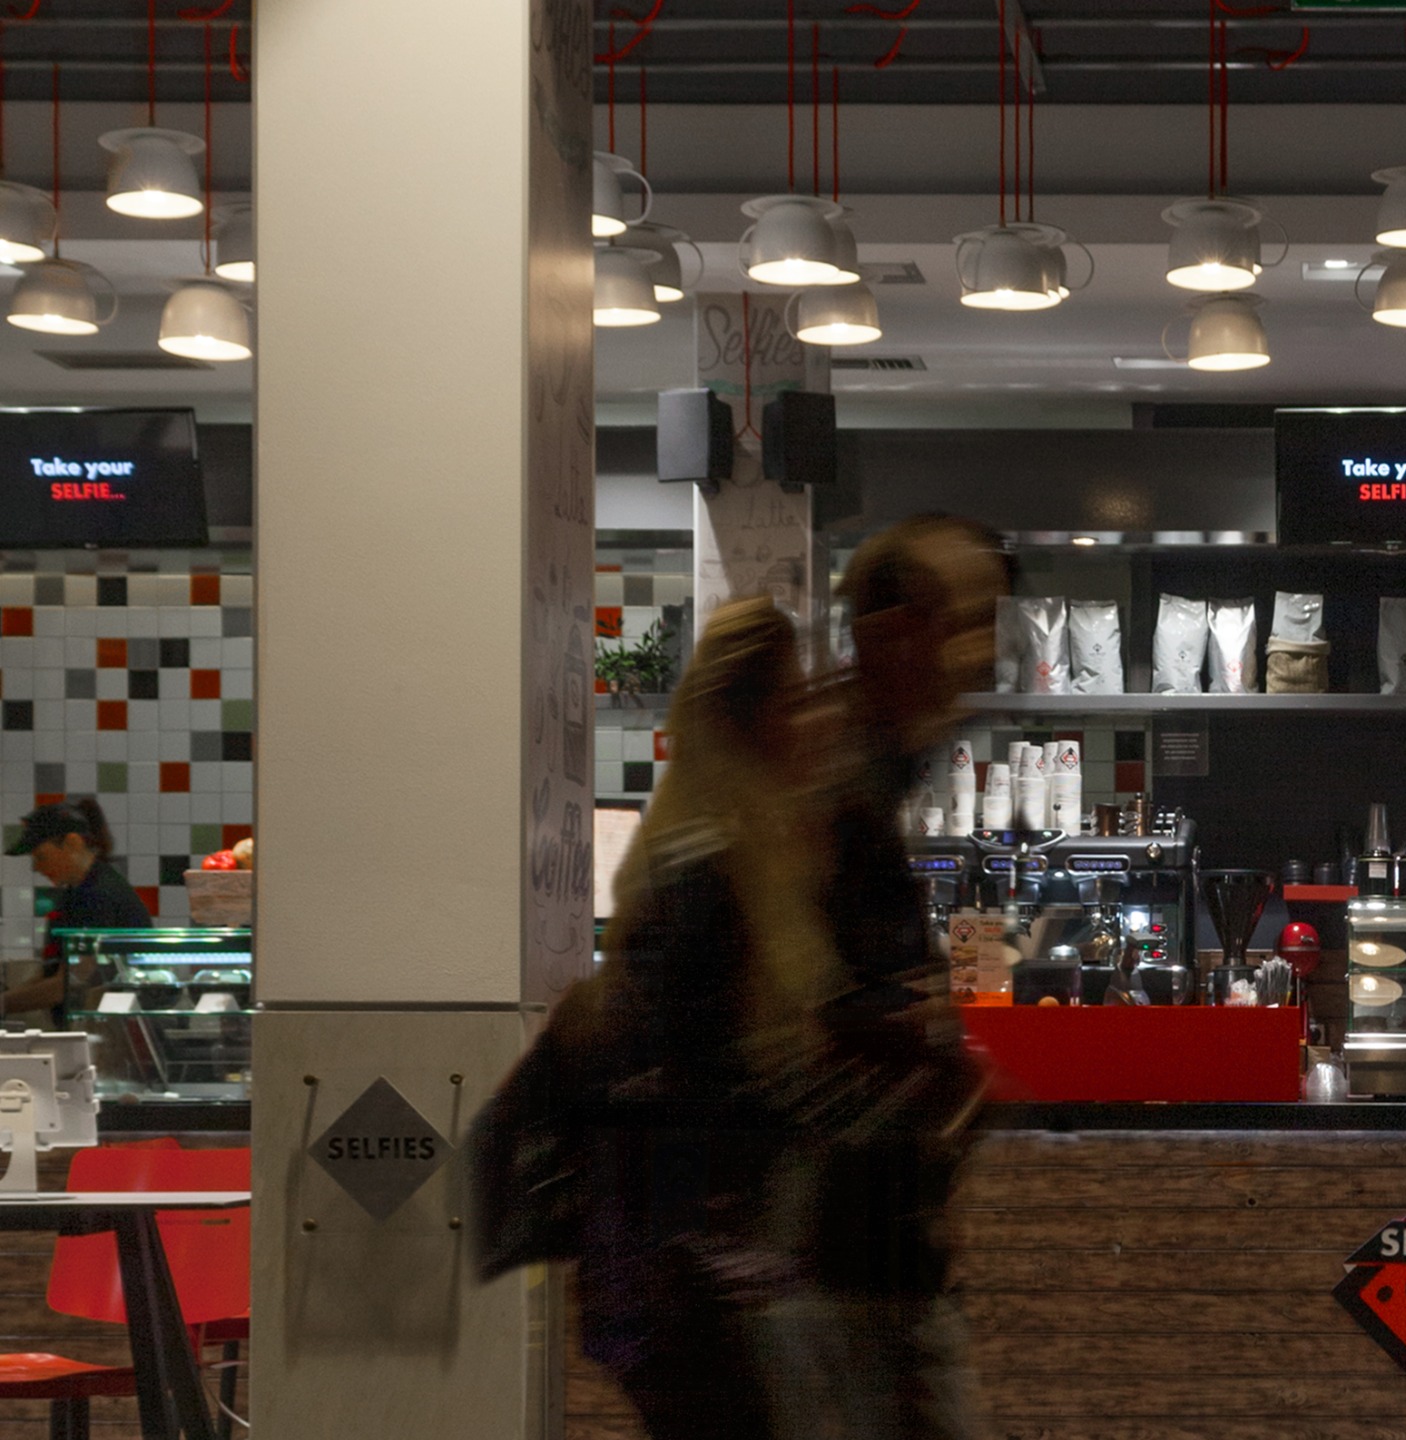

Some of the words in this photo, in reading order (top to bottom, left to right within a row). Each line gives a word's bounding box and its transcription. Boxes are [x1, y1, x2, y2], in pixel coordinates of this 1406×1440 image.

[30, 456, 82, 476] Take
[84, 461, 134, 480] your
[1341, 457, 1390, 476] Take
[328, 1137, 435, 1160] SELFIES
